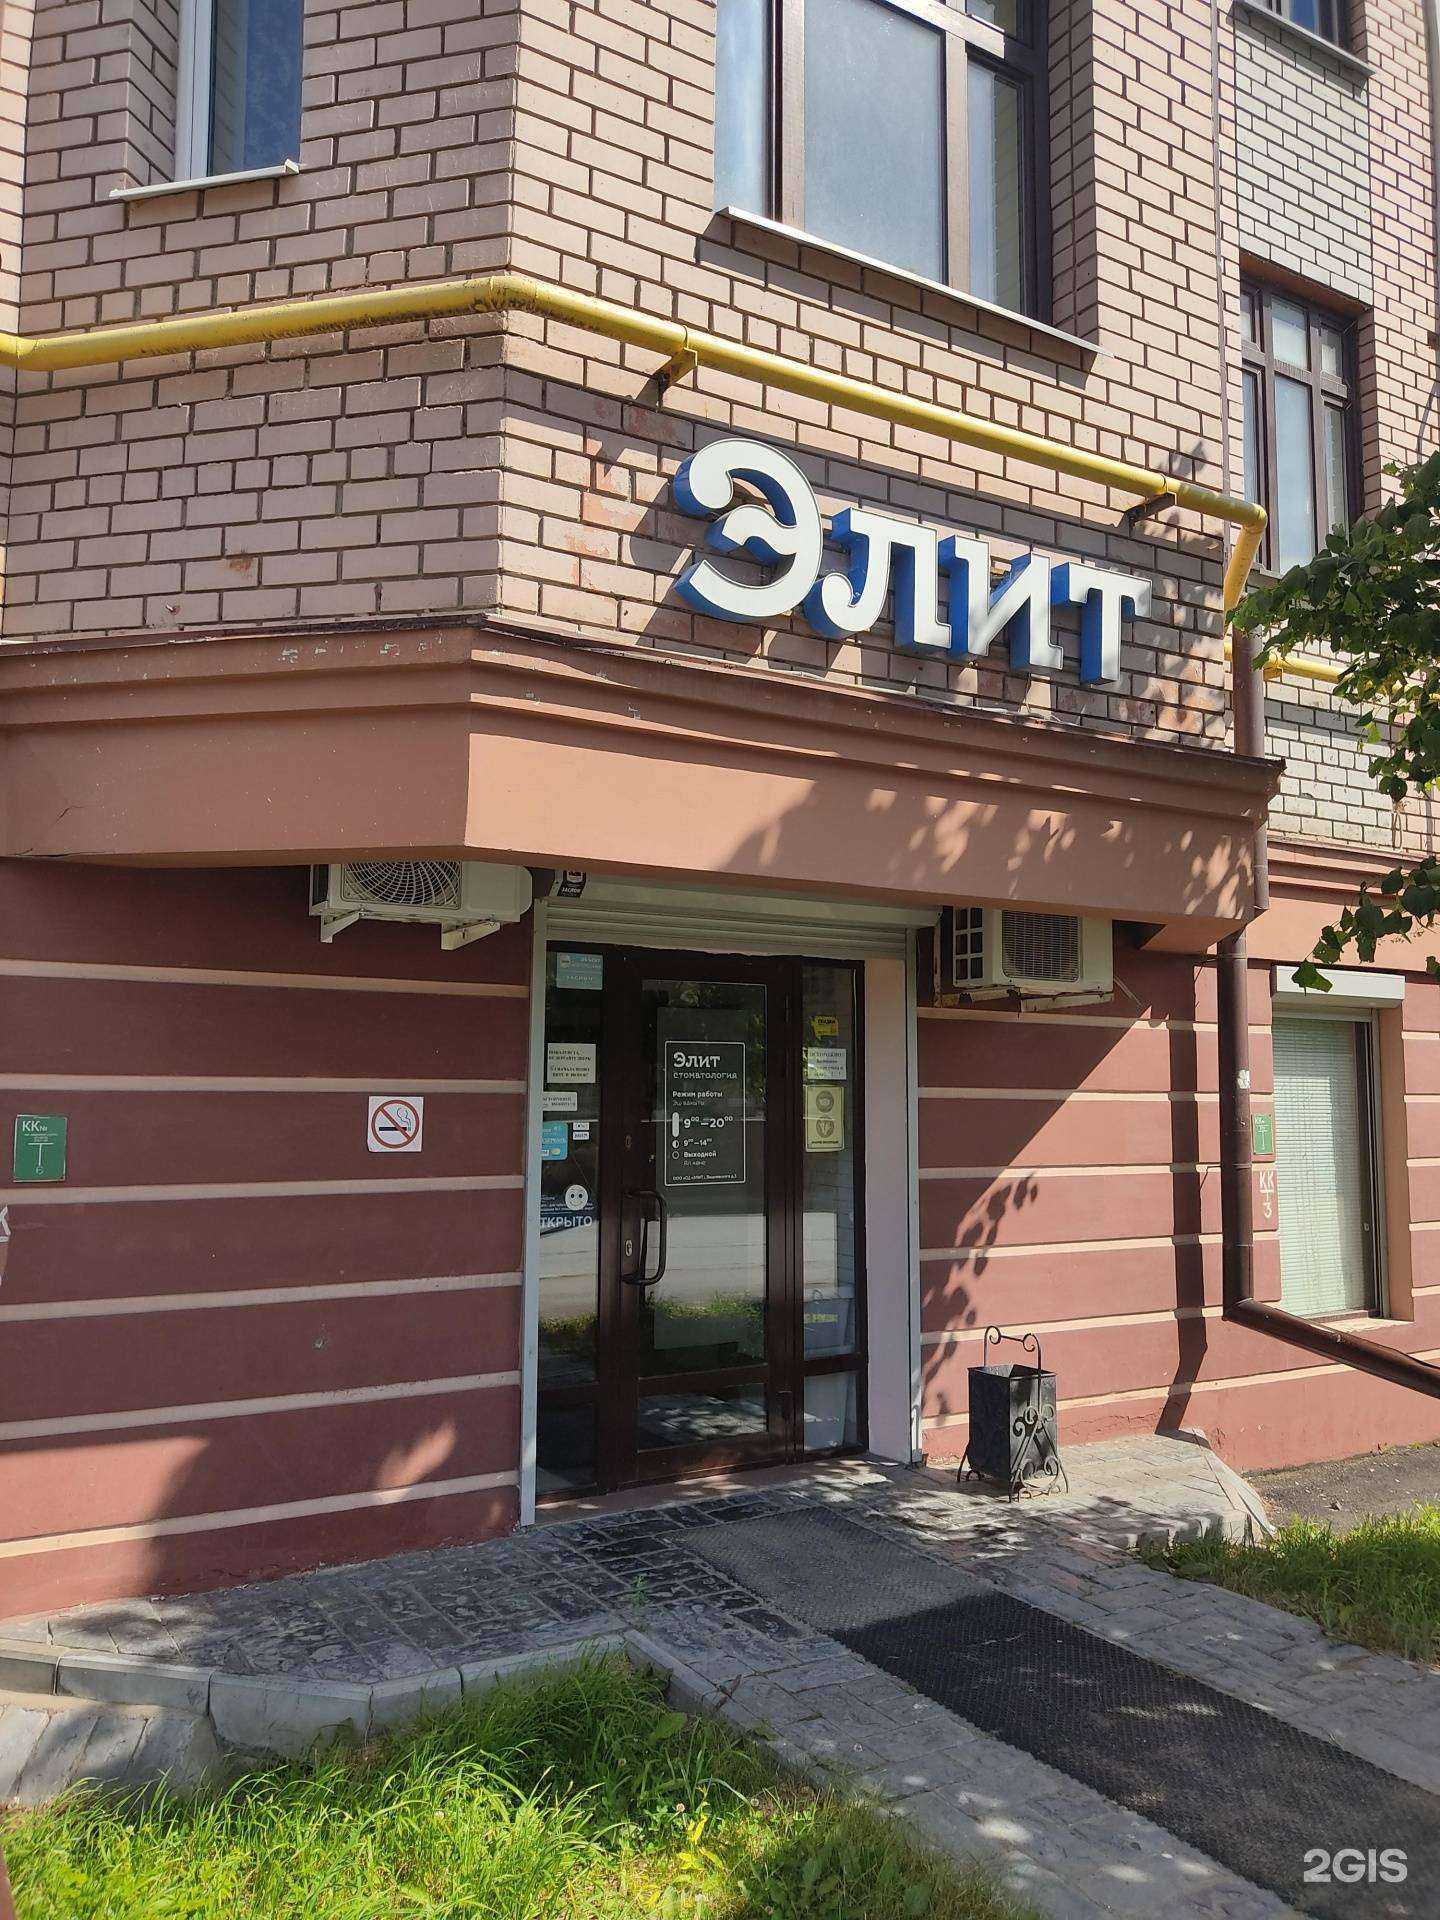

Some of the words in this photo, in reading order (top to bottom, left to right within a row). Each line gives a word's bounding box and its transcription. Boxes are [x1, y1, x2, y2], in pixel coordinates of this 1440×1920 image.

[673, 437, 1152, 685] Элит
[673, 1051, 721, 1068] Элит
[672, 1090, 696, 1098] Режим
[697, 1090, 723, 1099] работы
[540, 1215, 592, 1228] ТКРЫТО
